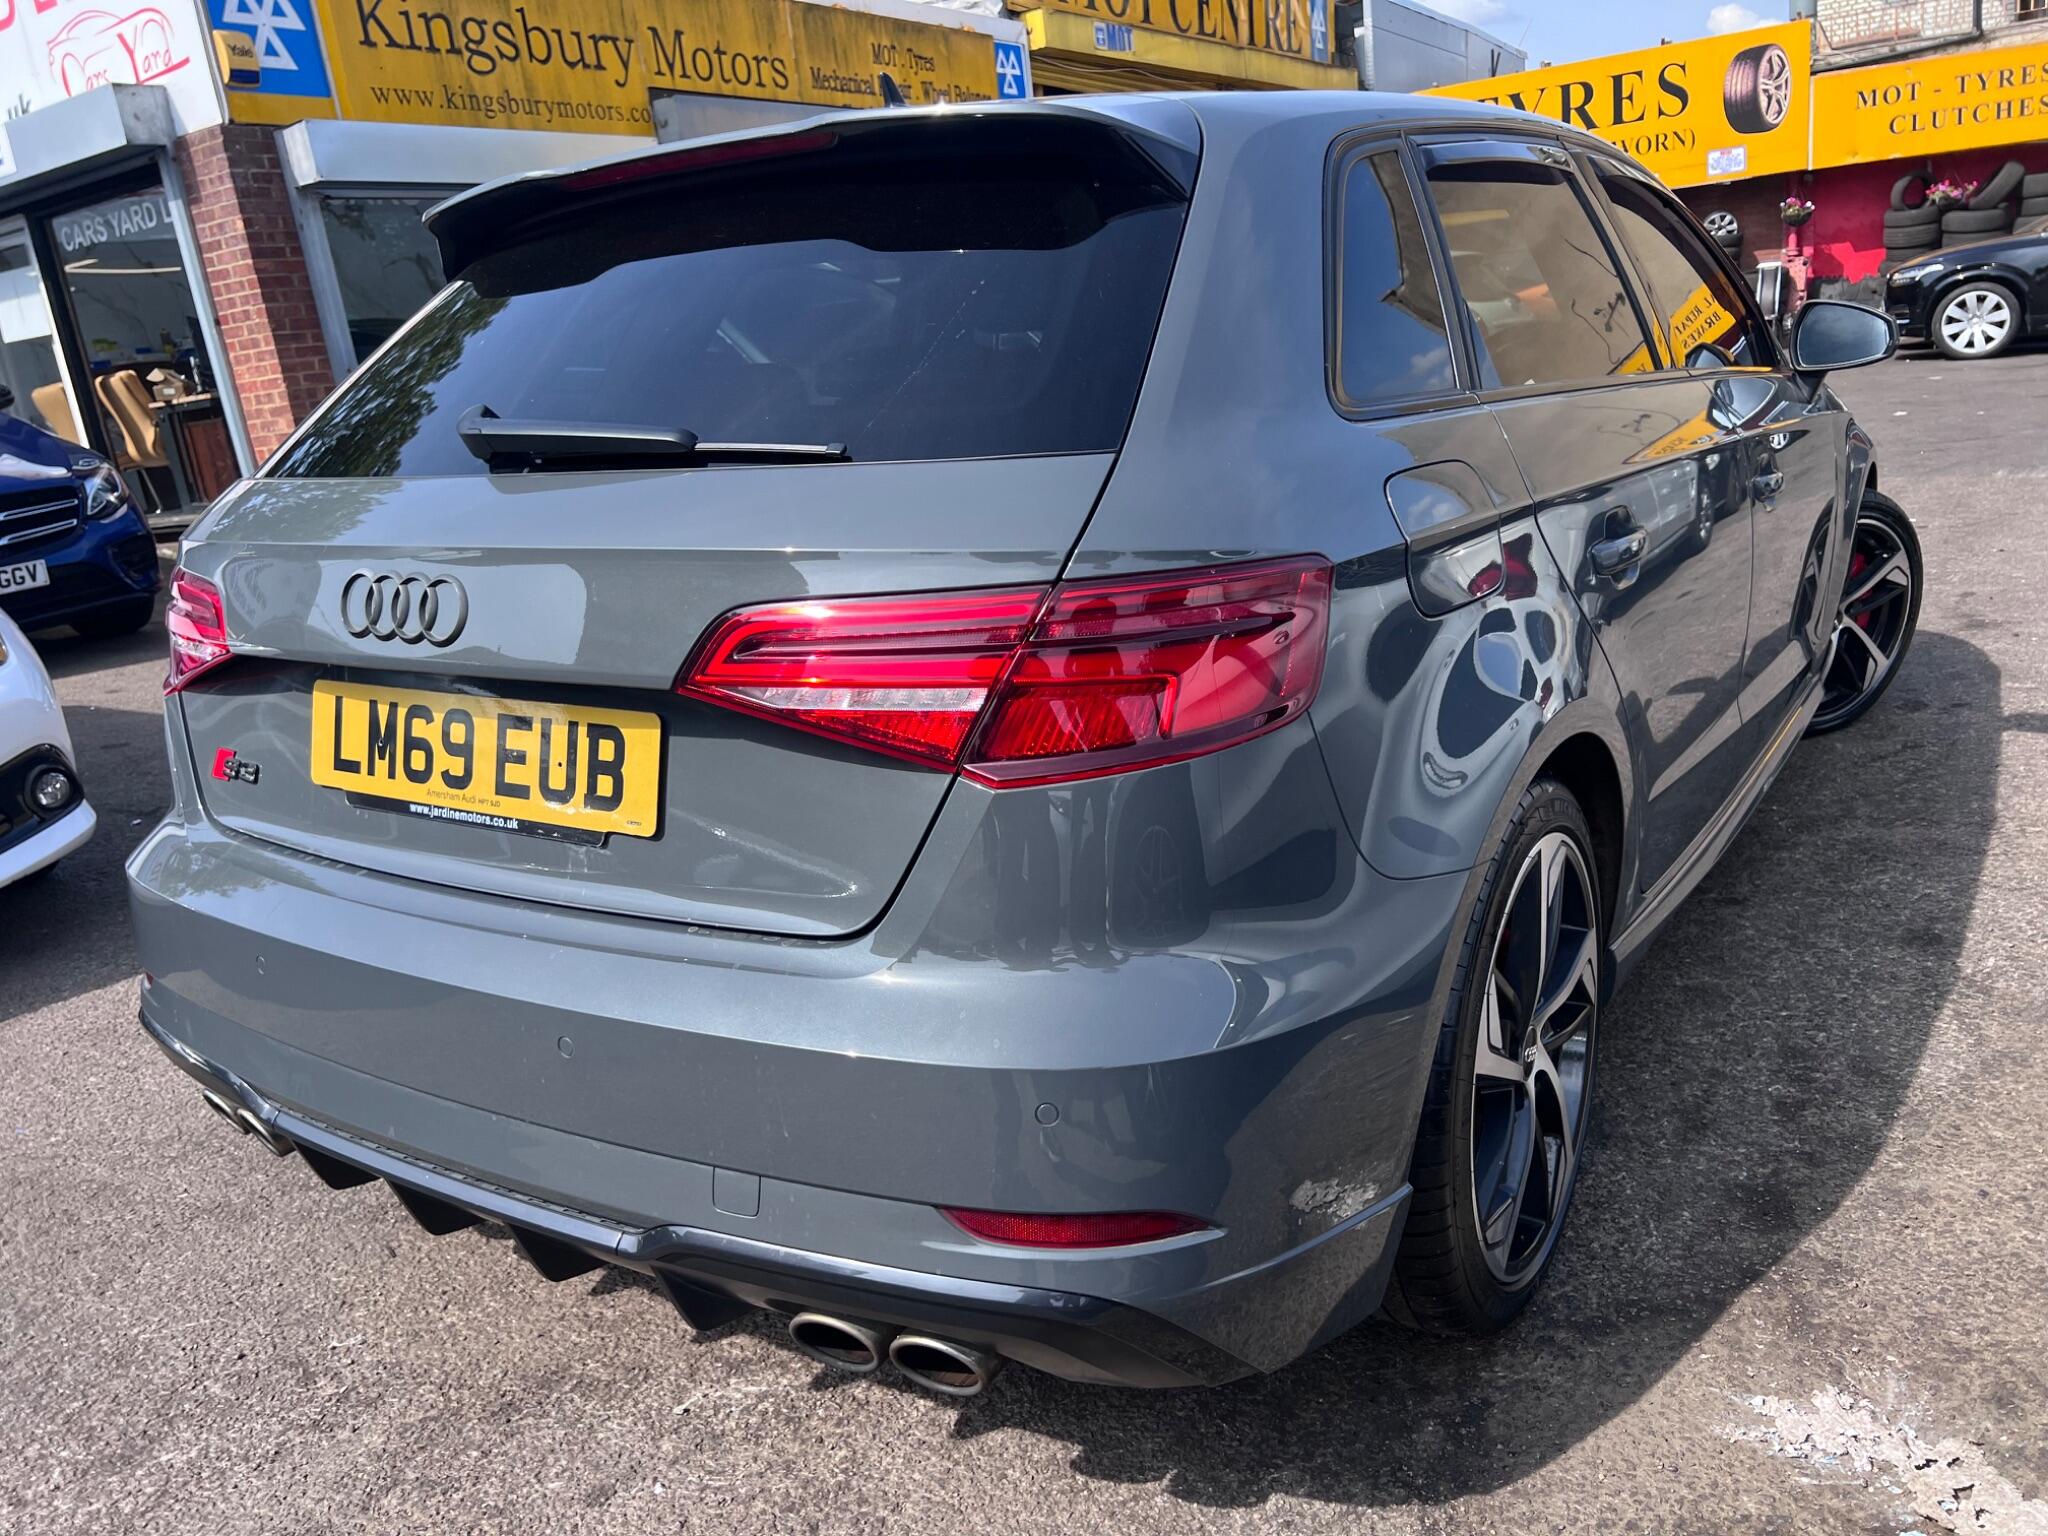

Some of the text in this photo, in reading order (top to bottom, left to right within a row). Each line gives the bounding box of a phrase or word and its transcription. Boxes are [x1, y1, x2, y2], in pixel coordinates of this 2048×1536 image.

[358, 0, 789, 90] Kingsbury Motors
[871, 42, 935, 75] MOT Tyres
[809, 66, 875, 97] Mechanical
[1856, 81, 1922, 110] MOT
[1955, 61, 2048, 95] TYRES
[1889, 94, 2048, 135] CLUTCHES
[60, 218, 109, 252] CARS
[108, 202, 158, 238] YARD
[332, 695, 626, 813] LM69 EUB
[409, 803, 519, 830] www.jardinemotors.co.uk
[461, 793, 477, 804] Audi
